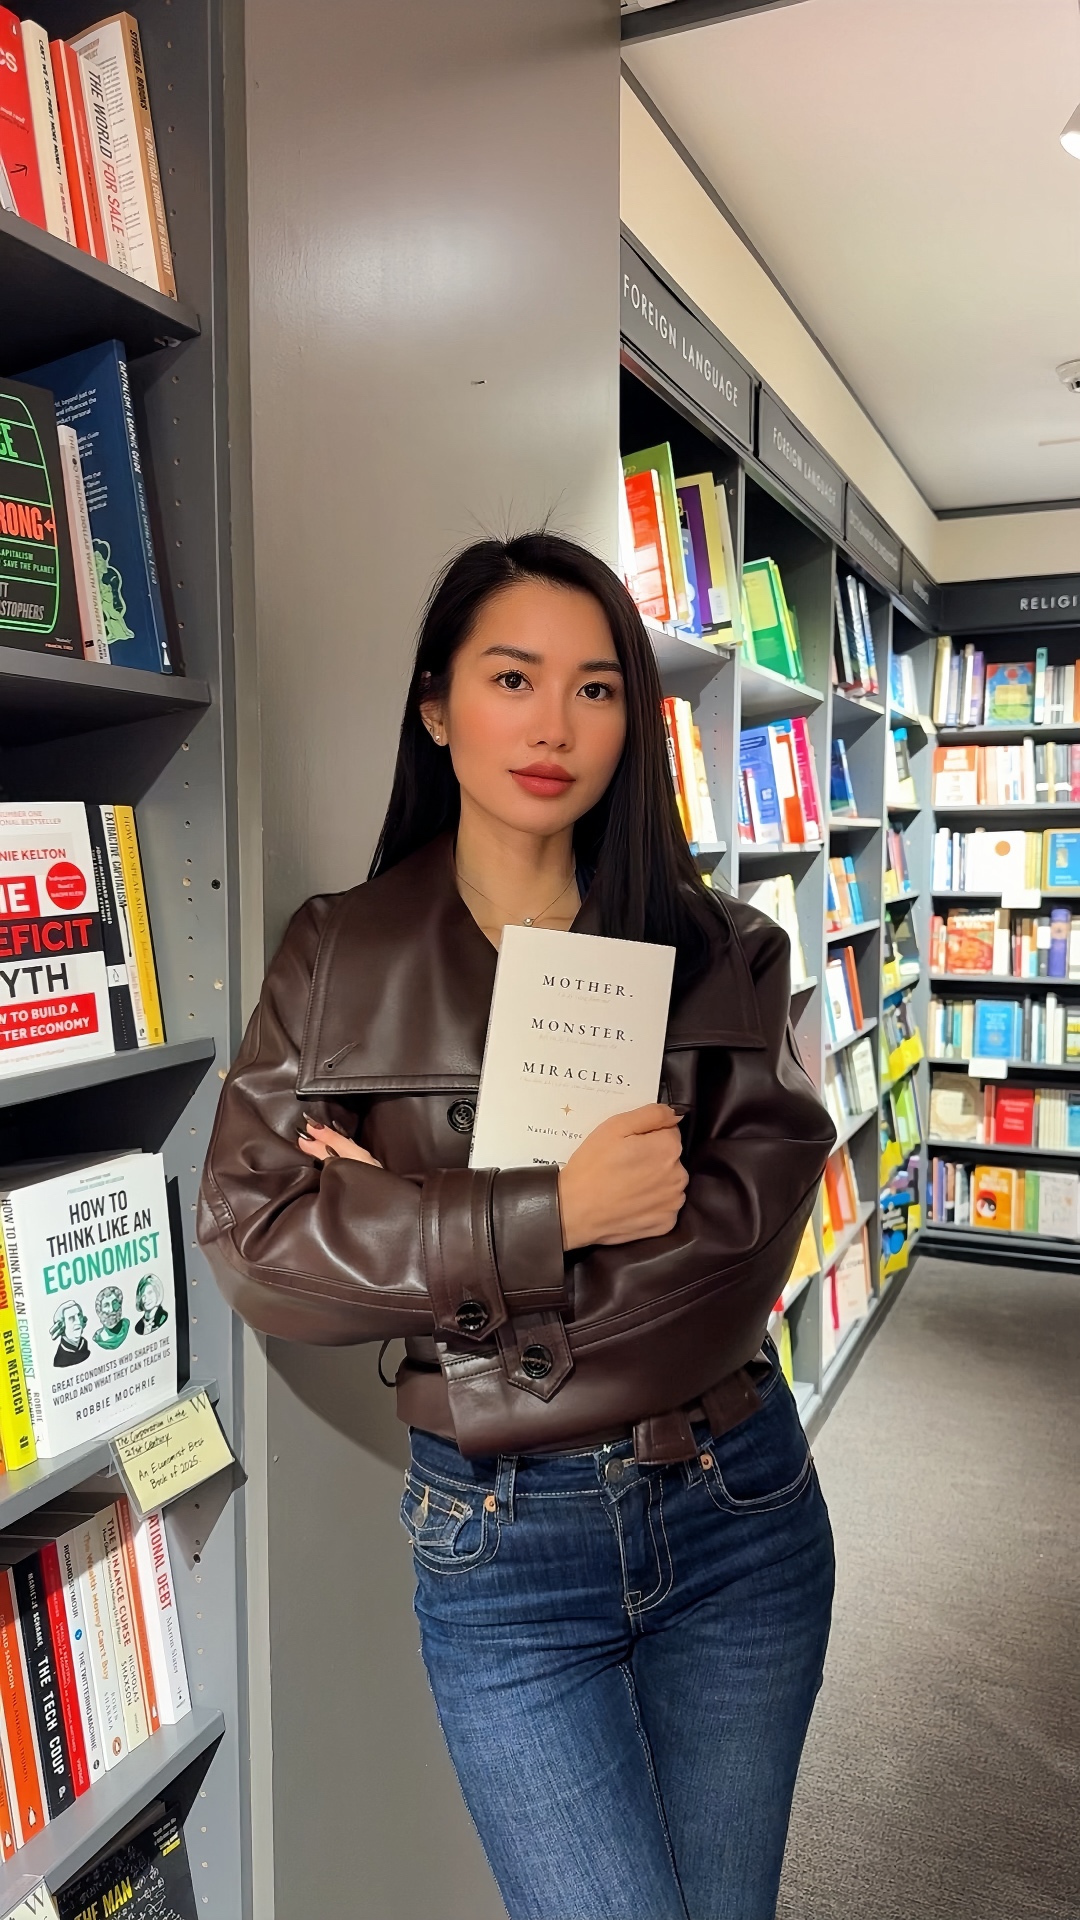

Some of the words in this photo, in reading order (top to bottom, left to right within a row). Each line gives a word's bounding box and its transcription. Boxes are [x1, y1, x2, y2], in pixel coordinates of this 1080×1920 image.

[88, 71, 104, 103] THE
[137, 76, 148, 111] BROOKS
[94, 102, 113, 159] WORLD
[102, 160, 118, 194] FOR
[108, 195, 125, 237] SALE
[146, 140, 157, 184] POLITICAL
[152, 183, 163, 222] ECONOMY
[159, 234, 172, 276] SECURITY
[623, 275, 678, 350] FOREIGN
[682, 337, 739, 408] LANGUAGE
[127, 417, 138, 449] GRAPHIC
[131, 450, 141, 474] GUIDE
[3, 560, 18, 569] SAVE
[20, 561, 31, 571] THE
[32, 563, 55, 575] PLANET
[80, 515, 91, 551] DOLLAR
[86, 552, 96, 589] WEALTH
[92, 591, 103, 635] TRANSFER
[1020, 594, 1077, 611] RELIGI
[104, 811, 121, 857] EXTRACTIVE
[123, 816, 133, 841] HOW
[21, 848, 67, 861] KELTON
[95, 846, 103, 865] JOHN
[128, 846, 135, 860] TO
[112, 861, 128, 908] CAPITALISM
[131, 862, 139, 894] SPEAK
[135, 898, 146, 934] MONEY
[542, 974, 633, 998] MOTHER.
[10, 1011, 29, 1023] TO
[31, 1004, 68, 1020] BUILD
[70, 1002, 79, 1014] A
[30, 1016, 90, 1037] ECONOMY
[531, 1017, 633, 1042] MONSTER.
[522, 1061, 630, 1086] MIRACLES.
[2, 1199, 15, 1223] HOW
[69, 1196, 105, 1225] HOW
[108, 1190, 128, 1213] TO
[5, 1227, 17, 1240] TO
[46, 1225, 96, 1258] THINK
[98, 1215, 130, 1243] LIKE
[133, 1208, 152, 1232] AN
[8, 1243, 21, 1274] THINK
[43, 1231, 160, 1295] ECONOMIST
[12, 1276, 25, 1298] LIKE
[15, 1301, 27, 1315] AN
[3, 1329, 16, 1355] BEN
[18, 1319, 36, 1380] ECONOMIST
[51, 1377, 74, 1394] GREAT
[76, 1359, 118, 1385] ECONOMISTS
[118, 1353, 133, 1366] WHO
[134, 1341, 158, 1359] SHAPED
[159, 1336, 170, 1348] THE
[52, 1390, 78, 1407] WORLD
[79, 1382, 93, 1396] AND
[94, 1374, 112, 1389] WHAT
[113, 1367, 129, 1381] THEY
[130, 1362, 142, 1374] CAN
[142, 1353, 161, 1368] TEACH
[162, 1348, 171, 1360] US
[8, 1358, 25, 1416] MEZRICH
[75, 1396, 111, 1421] ROBBIE
[114, 1375, 156, 1403] MOCHRIE
[188, 1392, 207, 1414] W
[34, 1392, 44, 1423] ROBBIE
[116, 1436, 129, 1447] The
[124, 1445, 143, 1457] 21st
[144, 1432, 173, 1452] Century
[138, 1469, 149, 1481] An
[150, 1446, 186, 1474] Economist
[149, 1474, 168, 1489] Book
[170, 1464, 179, 1478] of
[106, 1517, 117, 1541] THE
[63, 1543, 74, 1580] RICHARD
[87, 1552, 98, 1591] Wealth
[110, 1542, 126, 1605] FINANCE
[27, 1573, 38, 1609] MARIETJE
[68, 1579, 79, 1618] SEYMOUR
[156, 1572, 173, 1611] DEBT
[93, 1592, 102, 1628] Money
[118, 1604, 132, 1648] CURSE
[32, 1612, 44, 1647] SCHAAKE
[97, 1629, 107, 1659] Can't
[165, 1615, 175, 1649] Martin
[171, 1648, 179, 1674] Slater
[5, 1650, 15, 1689] SASSOON
[37, 1655, 52, 1688] THE
[78, 1650, 86, 1667] THE
[101, 1660, 110, 1680] Buy
[80, 1667, 93, 1713] TWITTERING
[121, 1660, 133, 1706] SHAXSON
[128, 1654, 140, 1703] NICHOLAS
[42, 1690, 59, 1731] TECH
[104, 1691, 114, 1731] SHARMA
[87, 1713, 98, 1751] MACHINE
[49, 1735, 65, 1775] COUP
[22, 1884, 45, 1915] W
[102, 1876, 133, 1917] MAN
